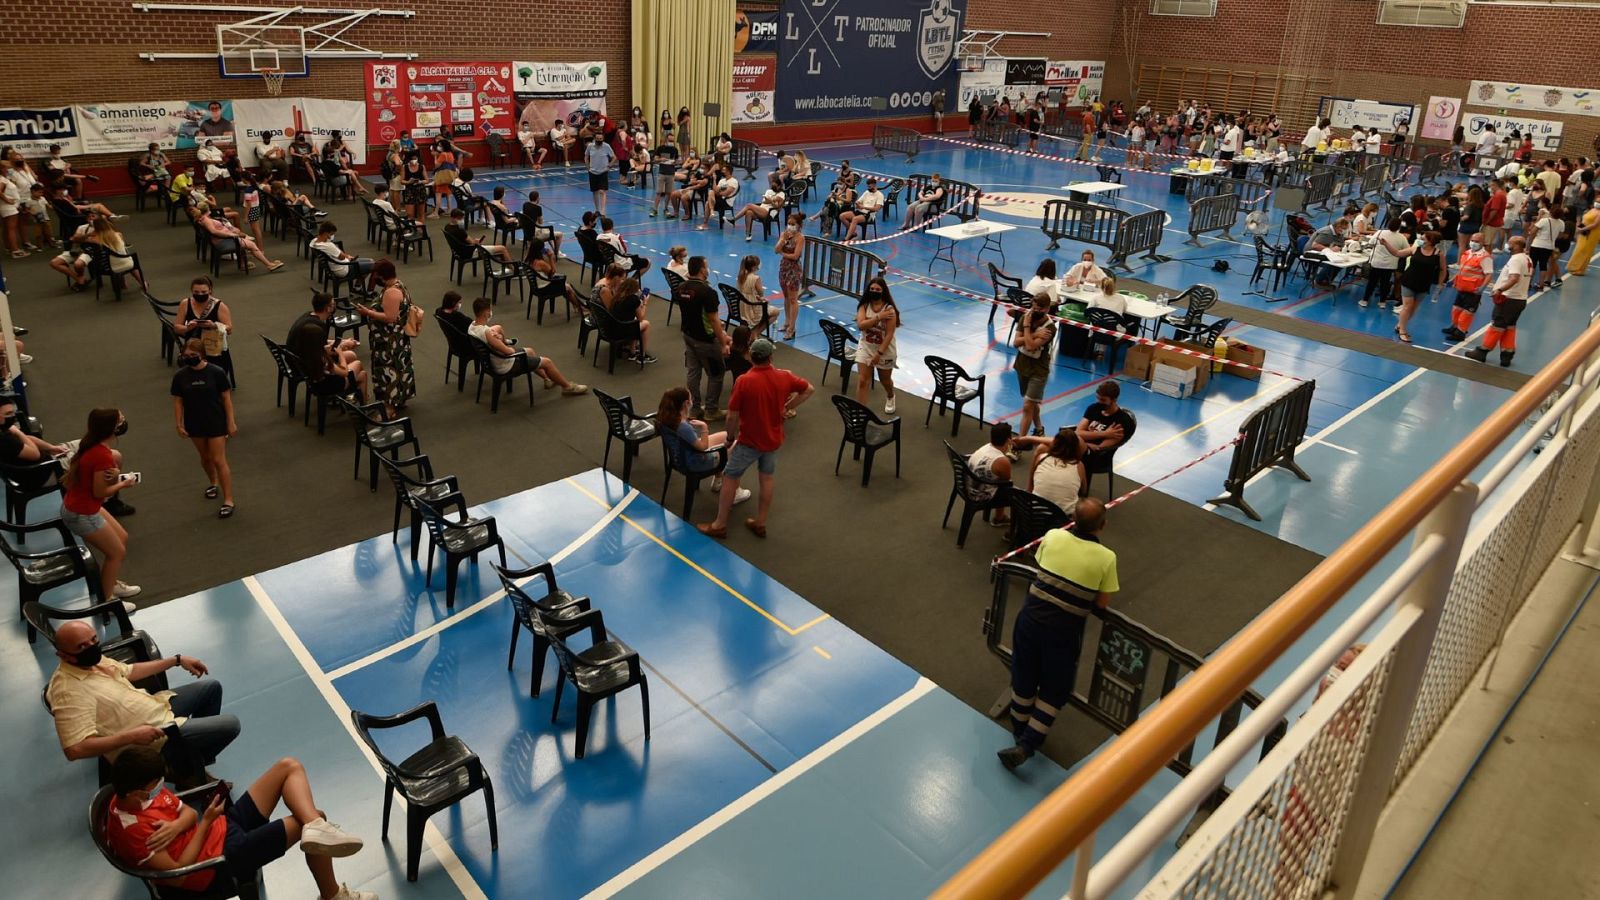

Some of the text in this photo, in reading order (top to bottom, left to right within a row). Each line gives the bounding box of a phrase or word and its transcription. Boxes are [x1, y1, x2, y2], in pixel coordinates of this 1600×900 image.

[751, 22, 778, 35] DFM
[855, 17, 912, 32] PATROCINADOR
[868, 34, 897, 49] OFICIAL
[420, 66, 477, 77] ALCANTARILLA
